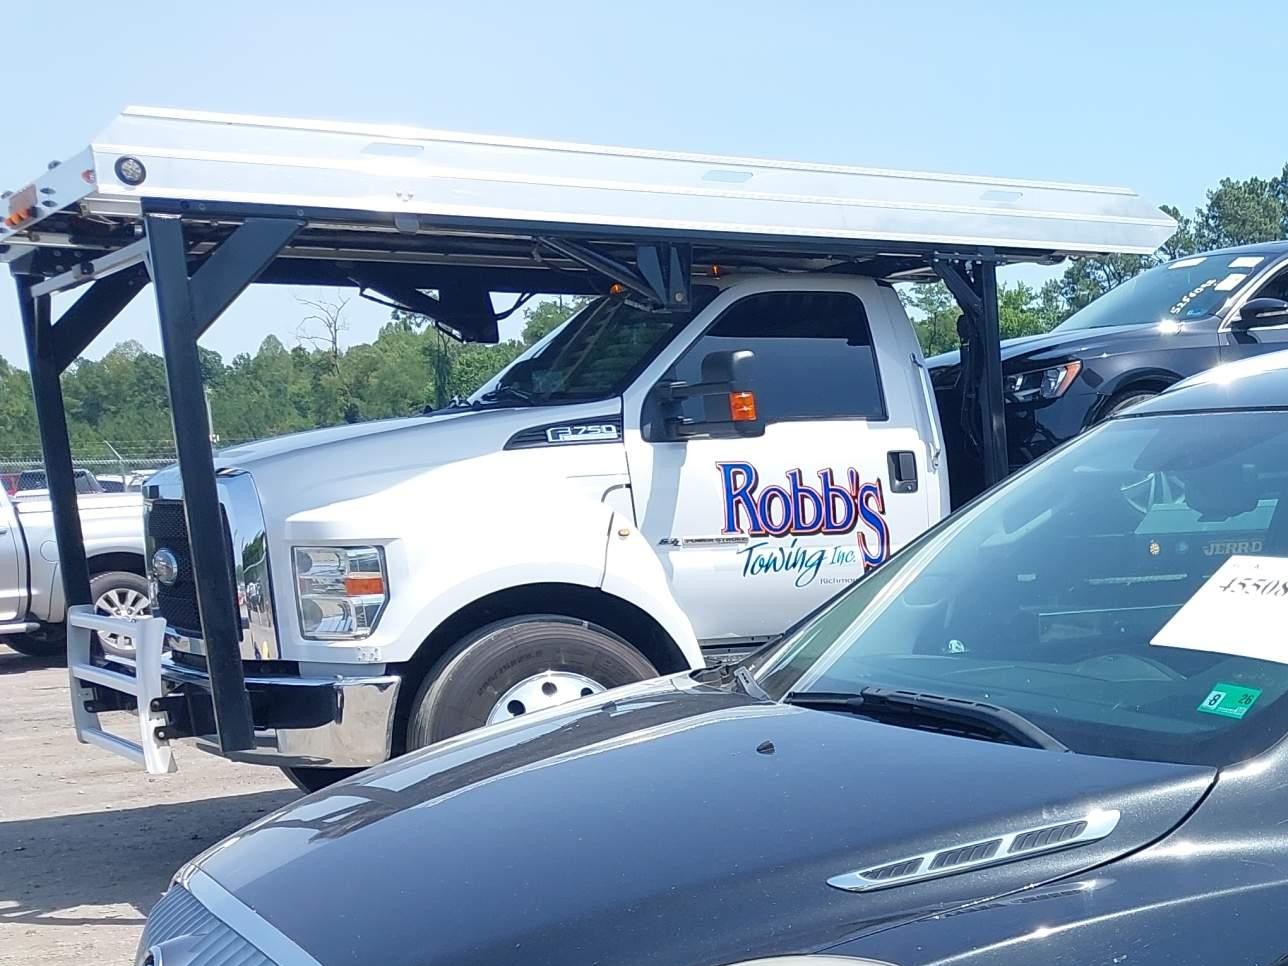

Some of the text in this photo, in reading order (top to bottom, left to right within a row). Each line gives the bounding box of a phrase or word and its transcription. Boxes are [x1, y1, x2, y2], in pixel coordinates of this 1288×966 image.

[715, 461, 891, 574] Robb's
[736, 538, 857, 588] Towing Inc.
[1208, 693, 1222, 707] 8
[1238, 693, 1255, 706] 26
